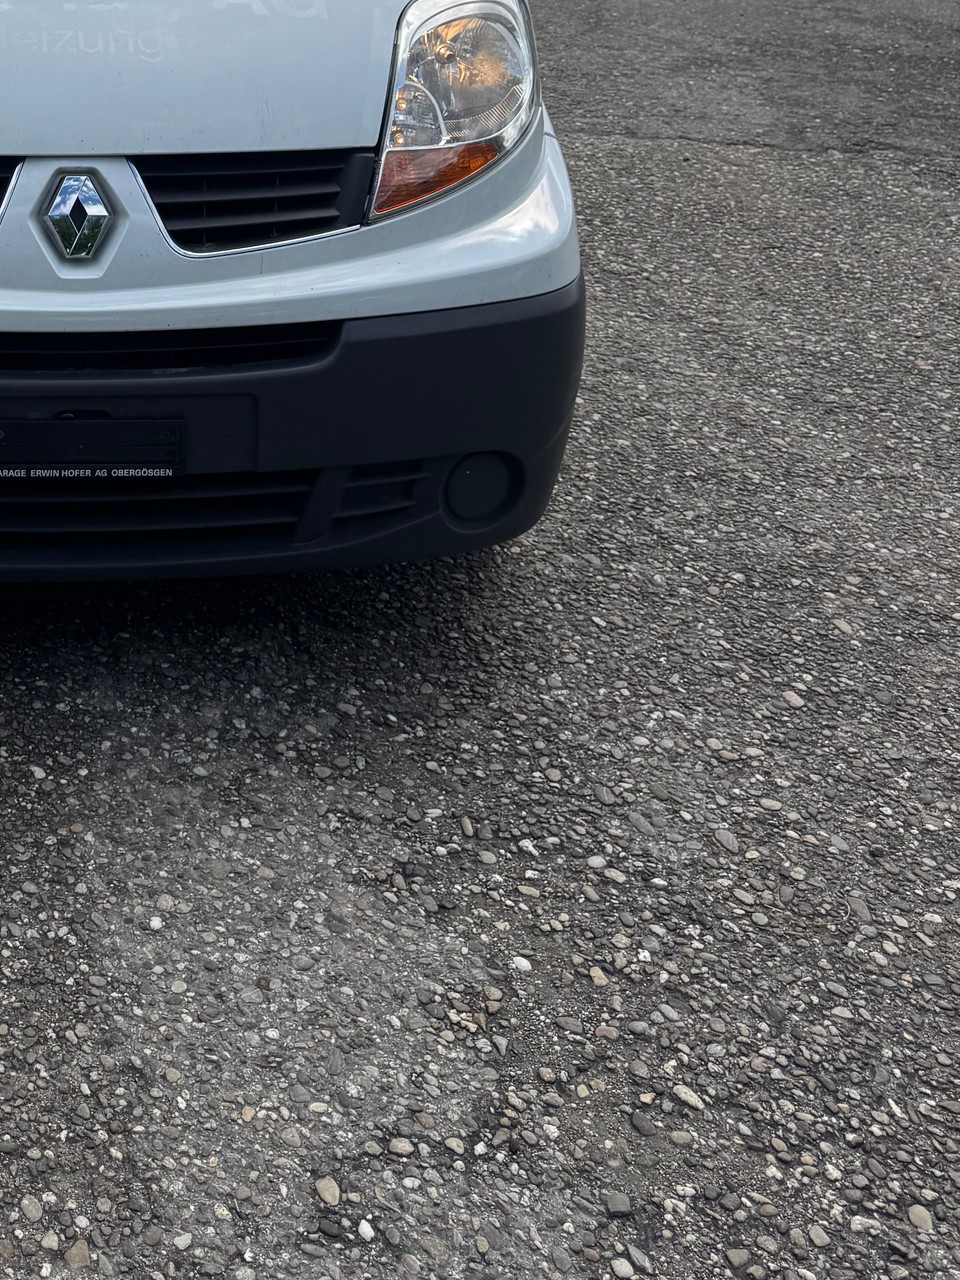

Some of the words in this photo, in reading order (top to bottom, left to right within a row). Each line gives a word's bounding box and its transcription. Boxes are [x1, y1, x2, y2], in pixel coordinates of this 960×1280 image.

[30, 469, 60, 477] ERWIN
[61, 469, 92, 477] HOFER
[94, 469, 108, 477] AG
[111, 467, 173, 477] OBERGÖSGEN
